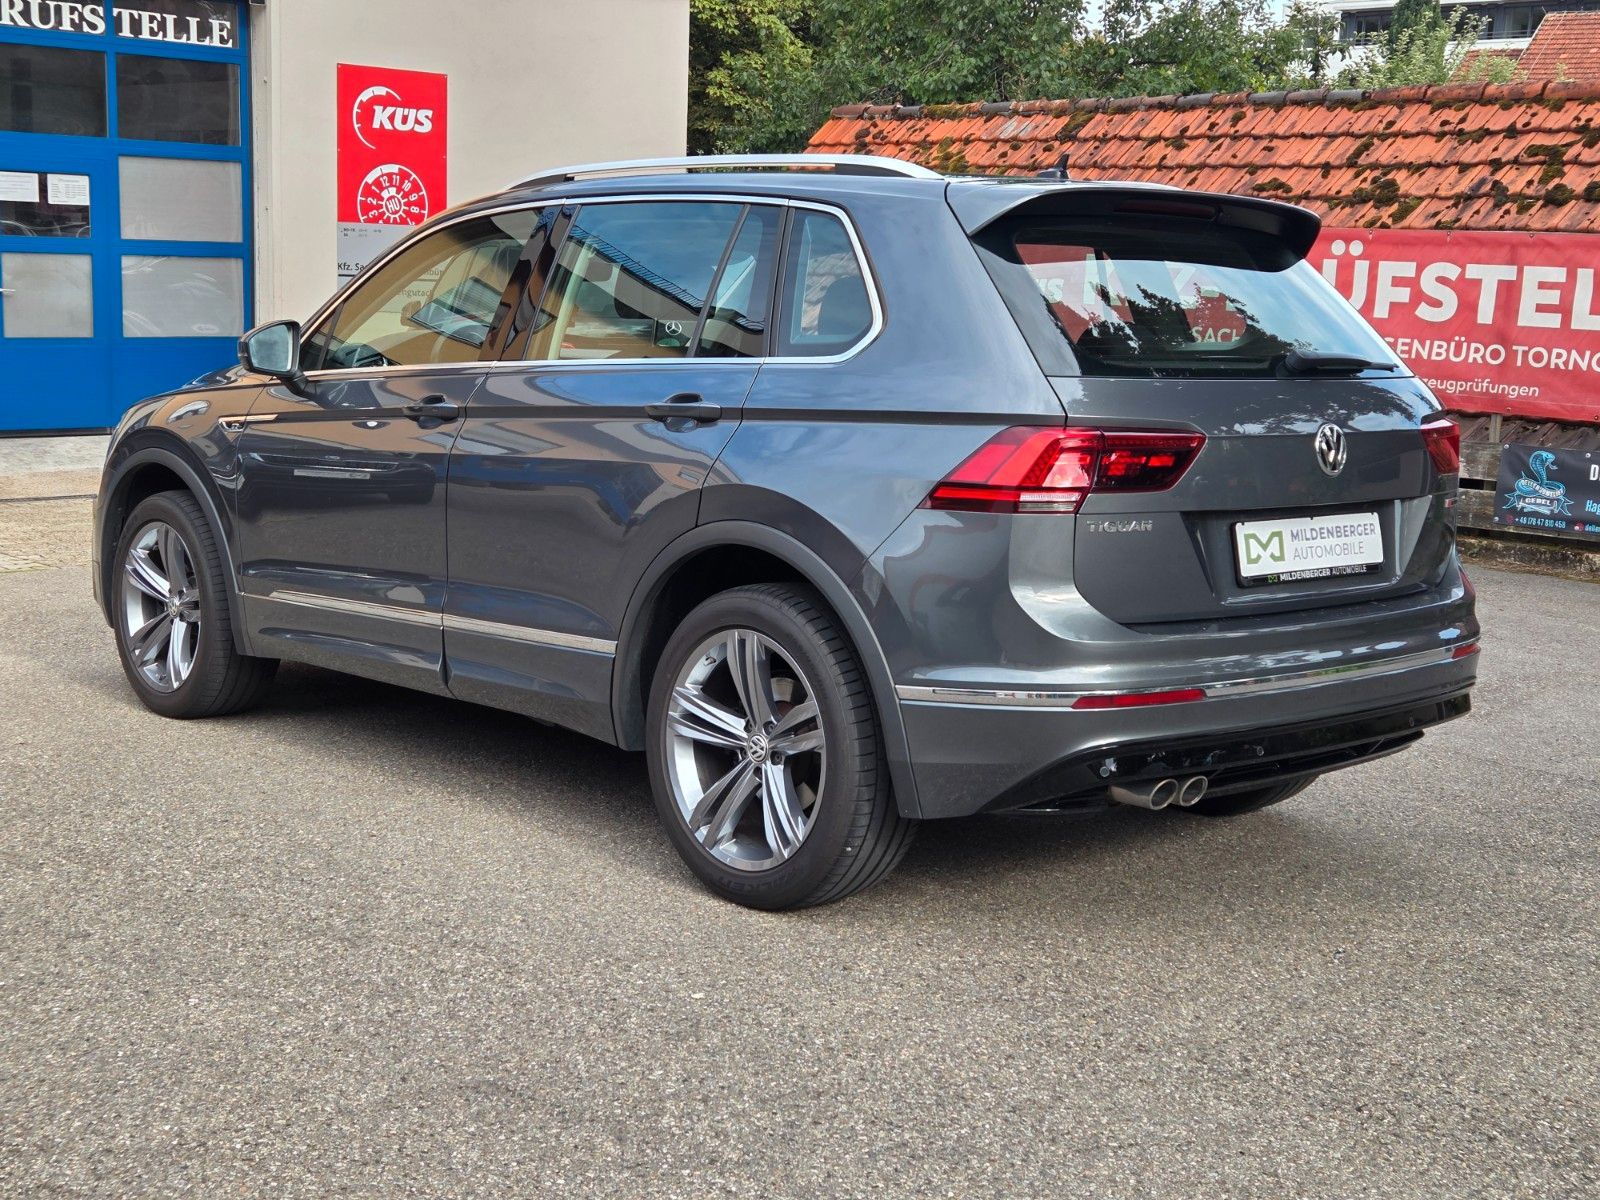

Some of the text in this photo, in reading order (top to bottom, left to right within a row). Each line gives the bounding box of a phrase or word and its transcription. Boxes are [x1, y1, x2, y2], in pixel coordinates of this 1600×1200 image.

[372, 104, 433, 133] KÜS
[380, 175, 390, 187] 12
[393, 175, 400, 186] 11
[402, 180, 411, 191] 10
[371, 185, 380, 193] 1
[367, 197, 377, 205] 2
[409, 193, 418, 201] 9
[386, 197, 400, 214] HU
[369, 209, 378, 218] 3
[337, 262, 353, 271] Kfz.
[1086, 520, 1153, 533] TIGUAN
[1291, 523, 1376, 543] MILDENBERGER
[1293, 541, 1365, 561] AUTOMOBILE
[1279, 564, 1367, 582] MILDENBERGER AUTOMOBILE
